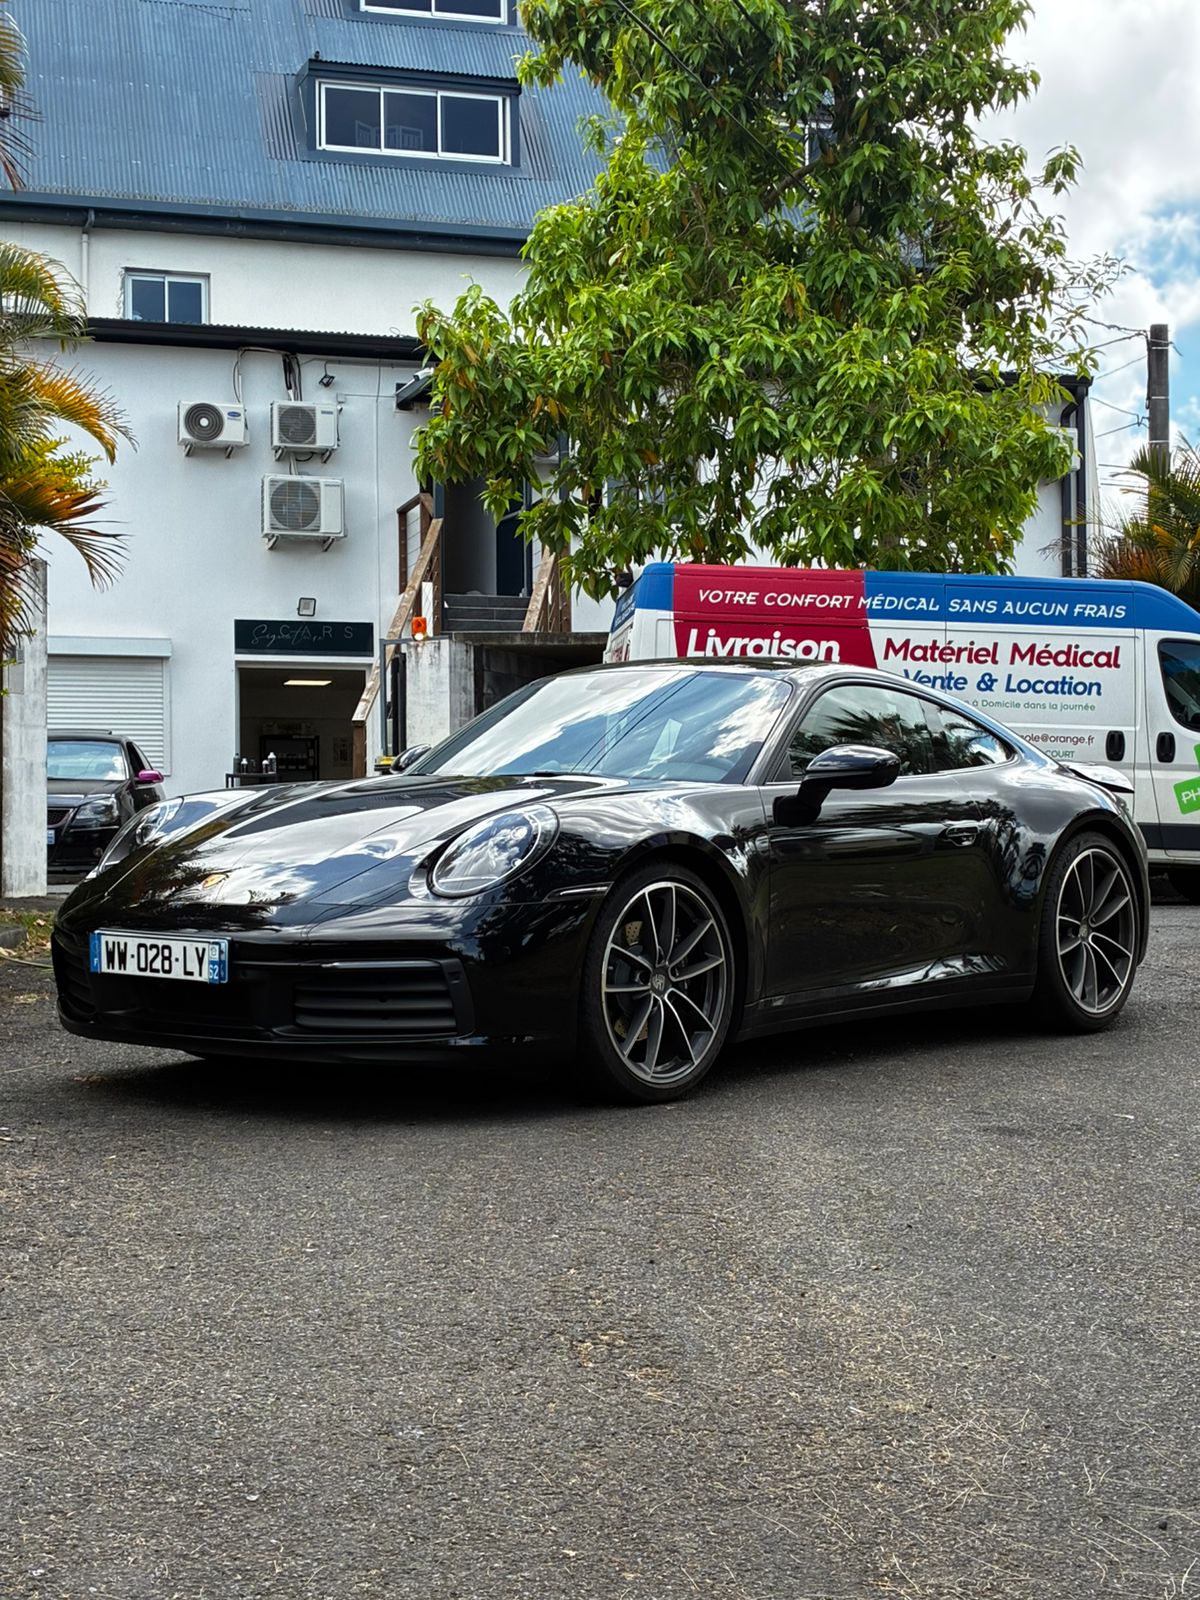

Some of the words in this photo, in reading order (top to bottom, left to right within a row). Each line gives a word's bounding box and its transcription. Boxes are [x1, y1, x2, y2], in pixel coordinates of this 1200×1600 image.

[699, 590, 760, 605] VOTRE
[764, 592, 854, 609] CONFORT
[858, 593, 939, 611] MÉDICAL
[948, 599, 998, 614] SANS
[1002, 602, 1069, 617] AUCUN
[1073, 604, 1126, 619] FRAIS
[686, 628, 841, 663] Livraison
[883, 637, 999, 666] Matériel
[1009, 642, 1121, 669] Médical
[903, 669, 968, 692] Vente
[976, 672, 998, 693] &
[1005, 673, 1102, 697] Location
[981, 699, 1021, 709] Domicile
[1023, 701, 1047, 710] dans
[1049, 701, 1058, 710] la
[1060, 702, 1096, 712] journée
